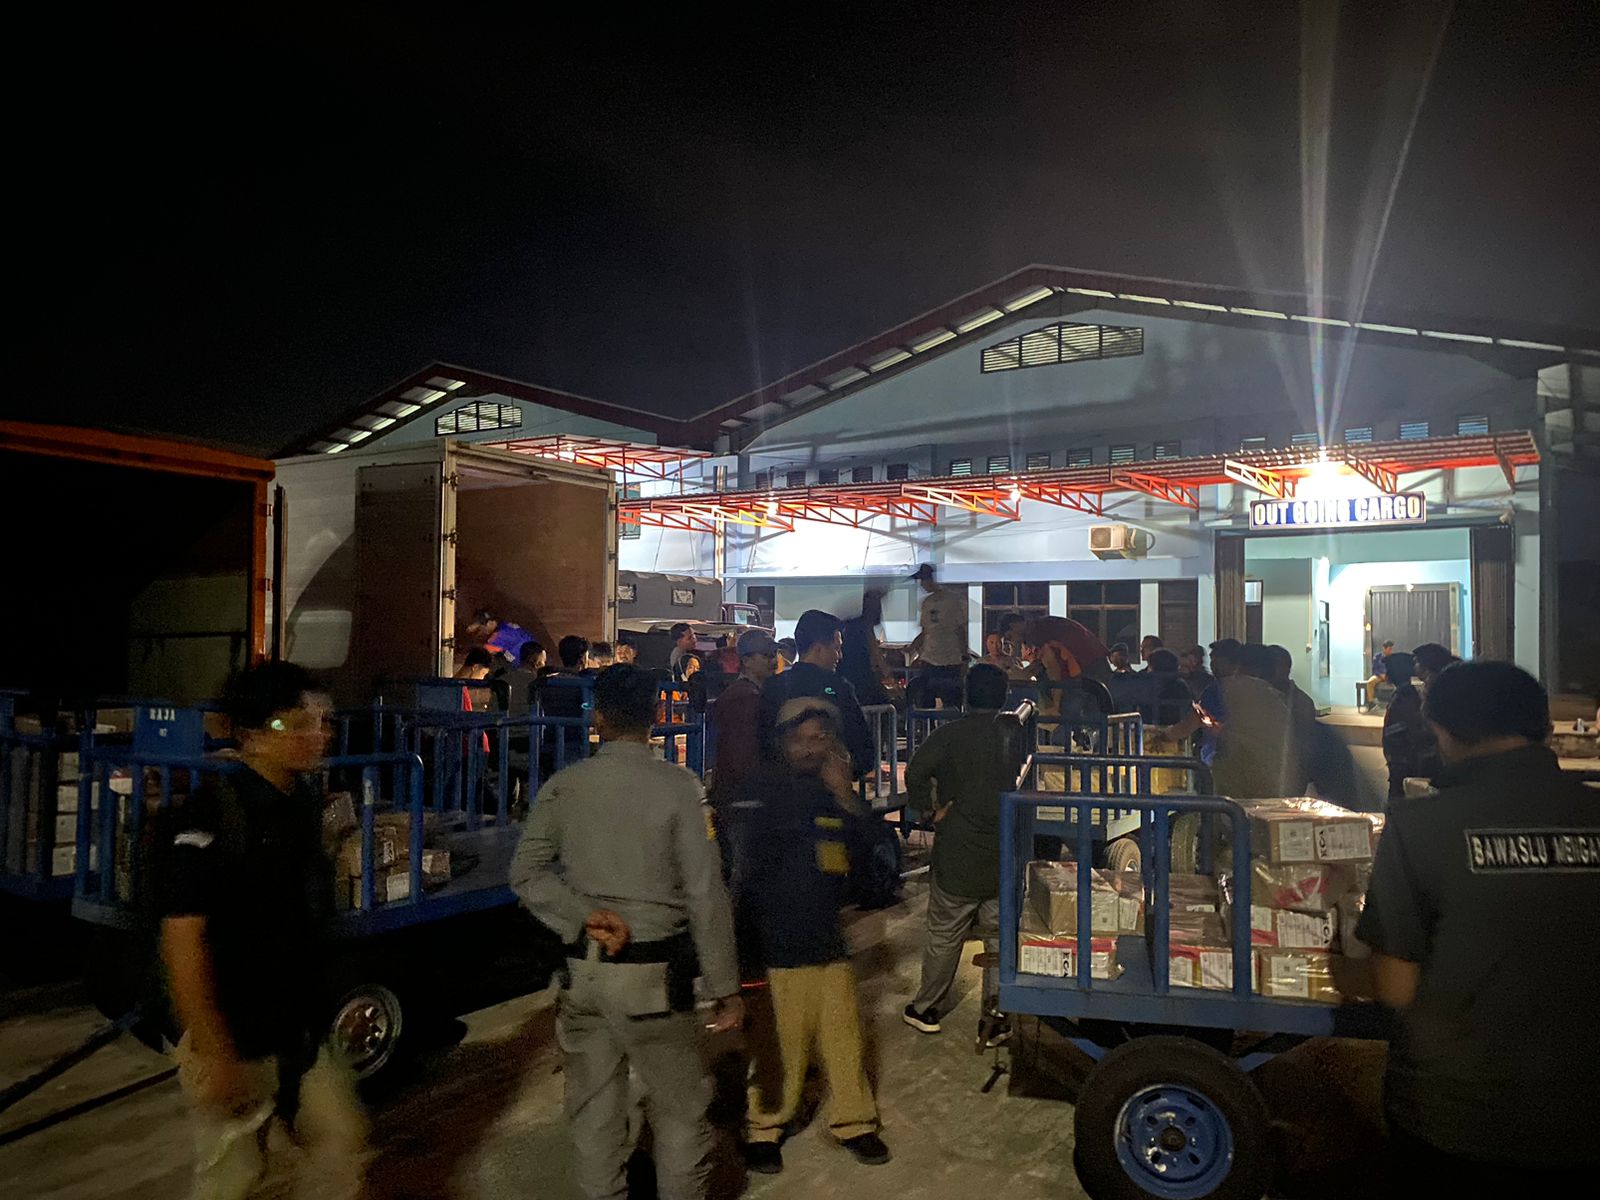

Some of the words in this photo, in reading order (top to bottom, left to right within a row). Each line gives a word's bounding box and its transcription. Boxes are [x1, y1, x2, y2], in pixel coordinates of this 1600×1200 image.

[1253, 503, 1288, 526] OUT
[1293, 499, 1350, 524] GOING
[1355, 495, 1421, 522] CARGO
[1470, 834, 1549, 867] BAWASLU
